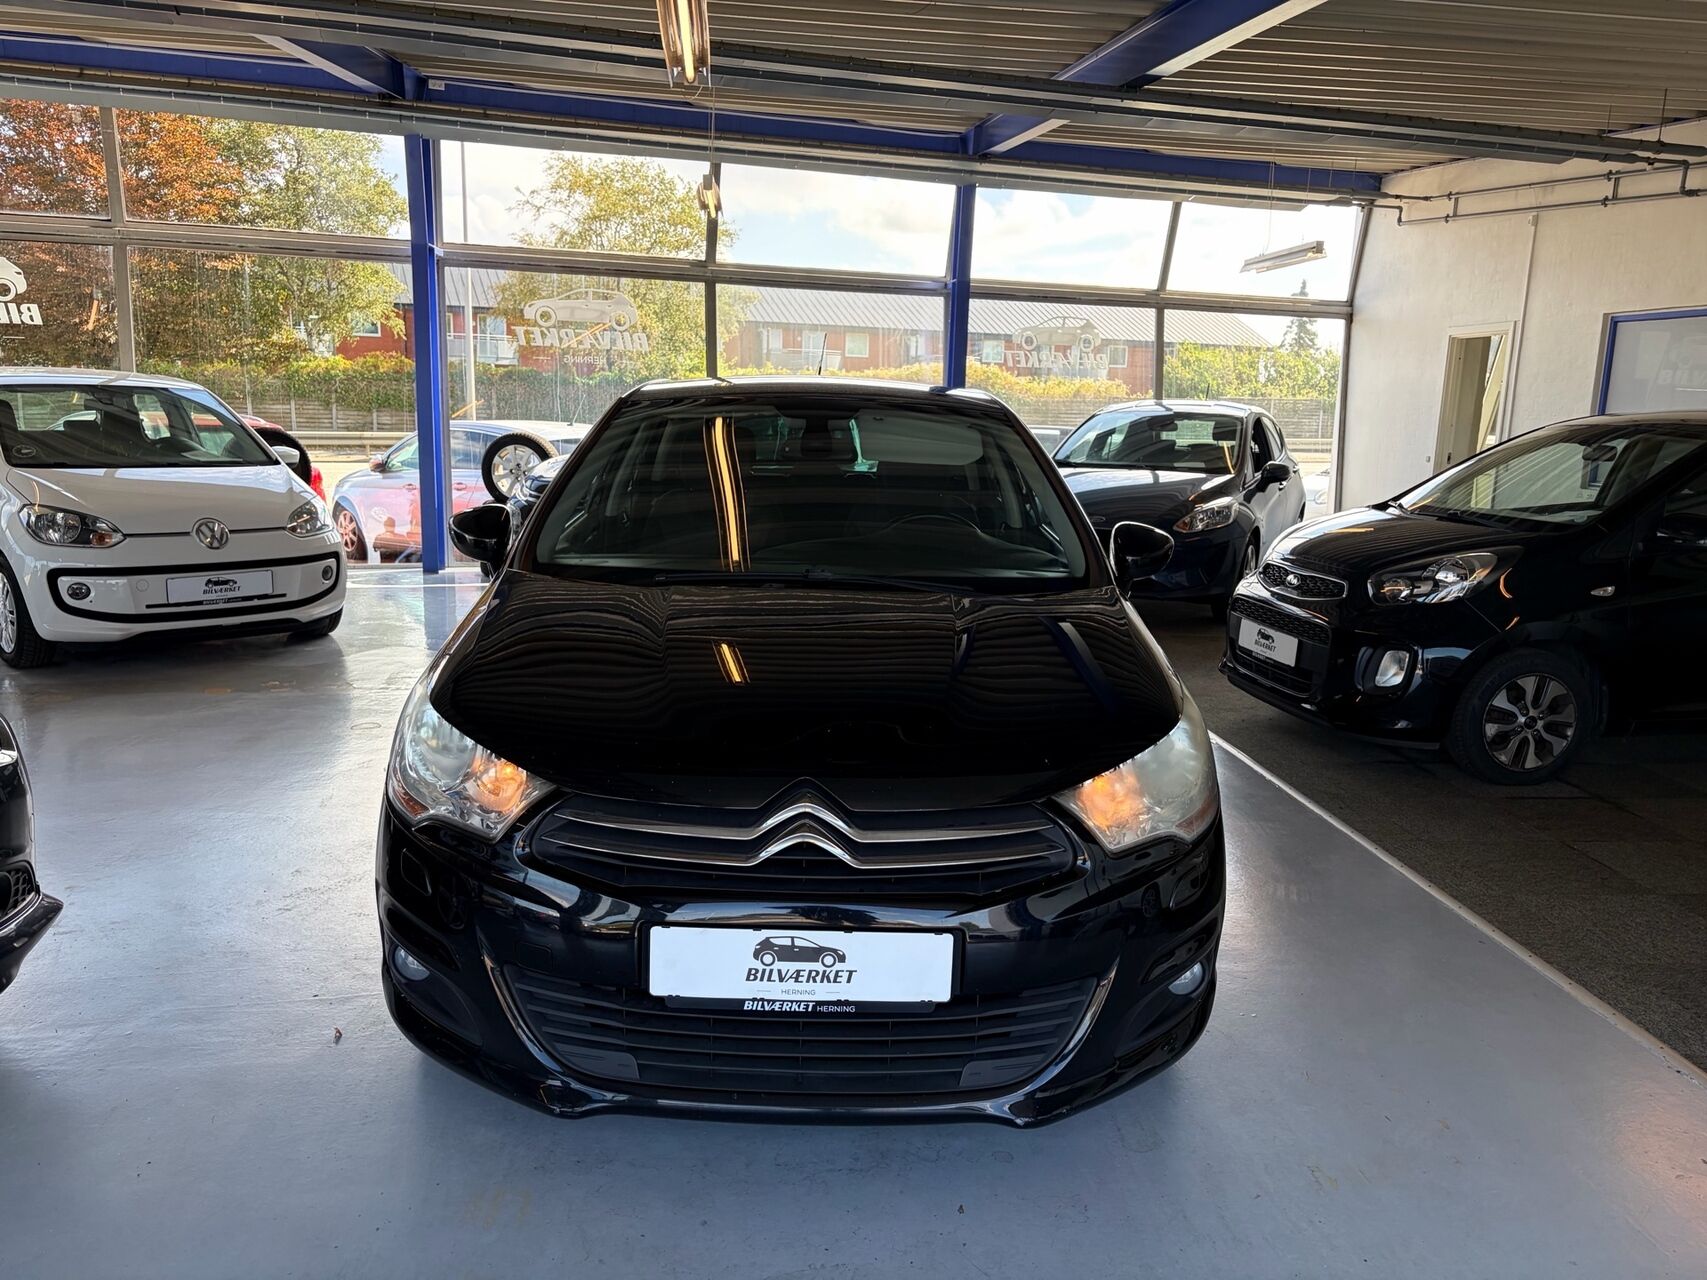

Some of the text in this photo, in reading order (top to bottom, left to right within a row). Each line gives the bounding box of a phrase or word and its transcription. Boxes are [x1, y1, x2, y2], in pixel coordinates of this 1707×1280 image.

[745, 967, 857, 984] BILVÆRKET
[781, 988, 816, 996] HERNING
[744, 1000, 856, 1013] BILVÆRKET HERNING
